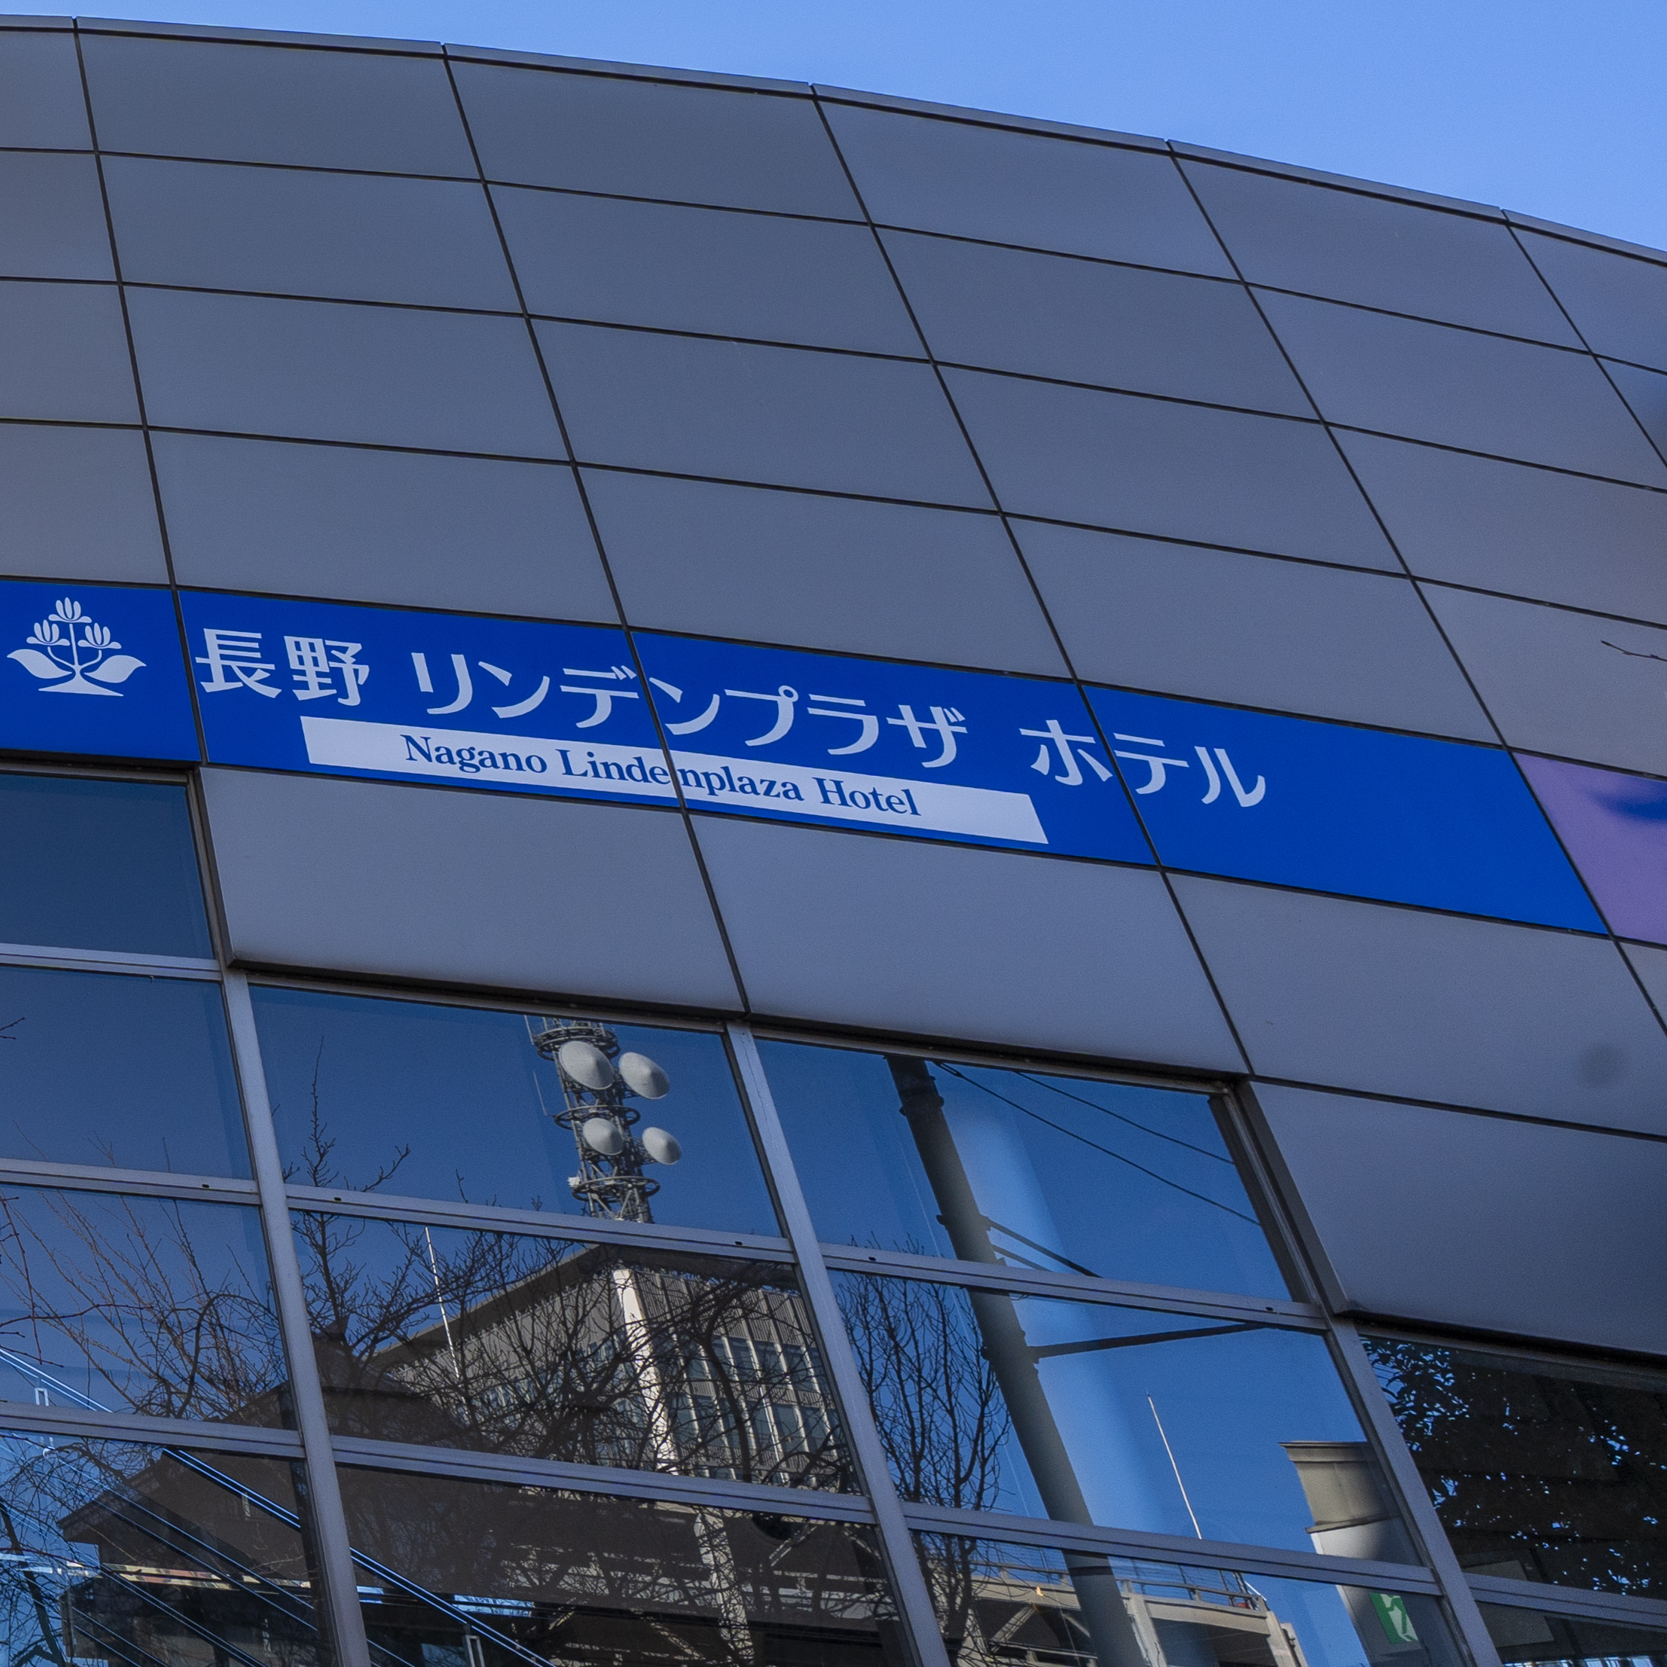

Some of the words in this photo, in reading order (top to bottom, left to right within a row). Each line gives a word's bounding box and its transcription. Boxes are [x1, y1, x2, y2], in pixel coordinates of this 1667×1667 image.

[195, 628, 370, 706] 長野
[411, 652, 968, 768] リンデンプラザ
[1019, 719, 1266, 807] ホテル
[399, 734, 548, 774] Nagano
[555, 748, 805, 802] Lindenplaza
[811, 776, 922, 817] Hotel
